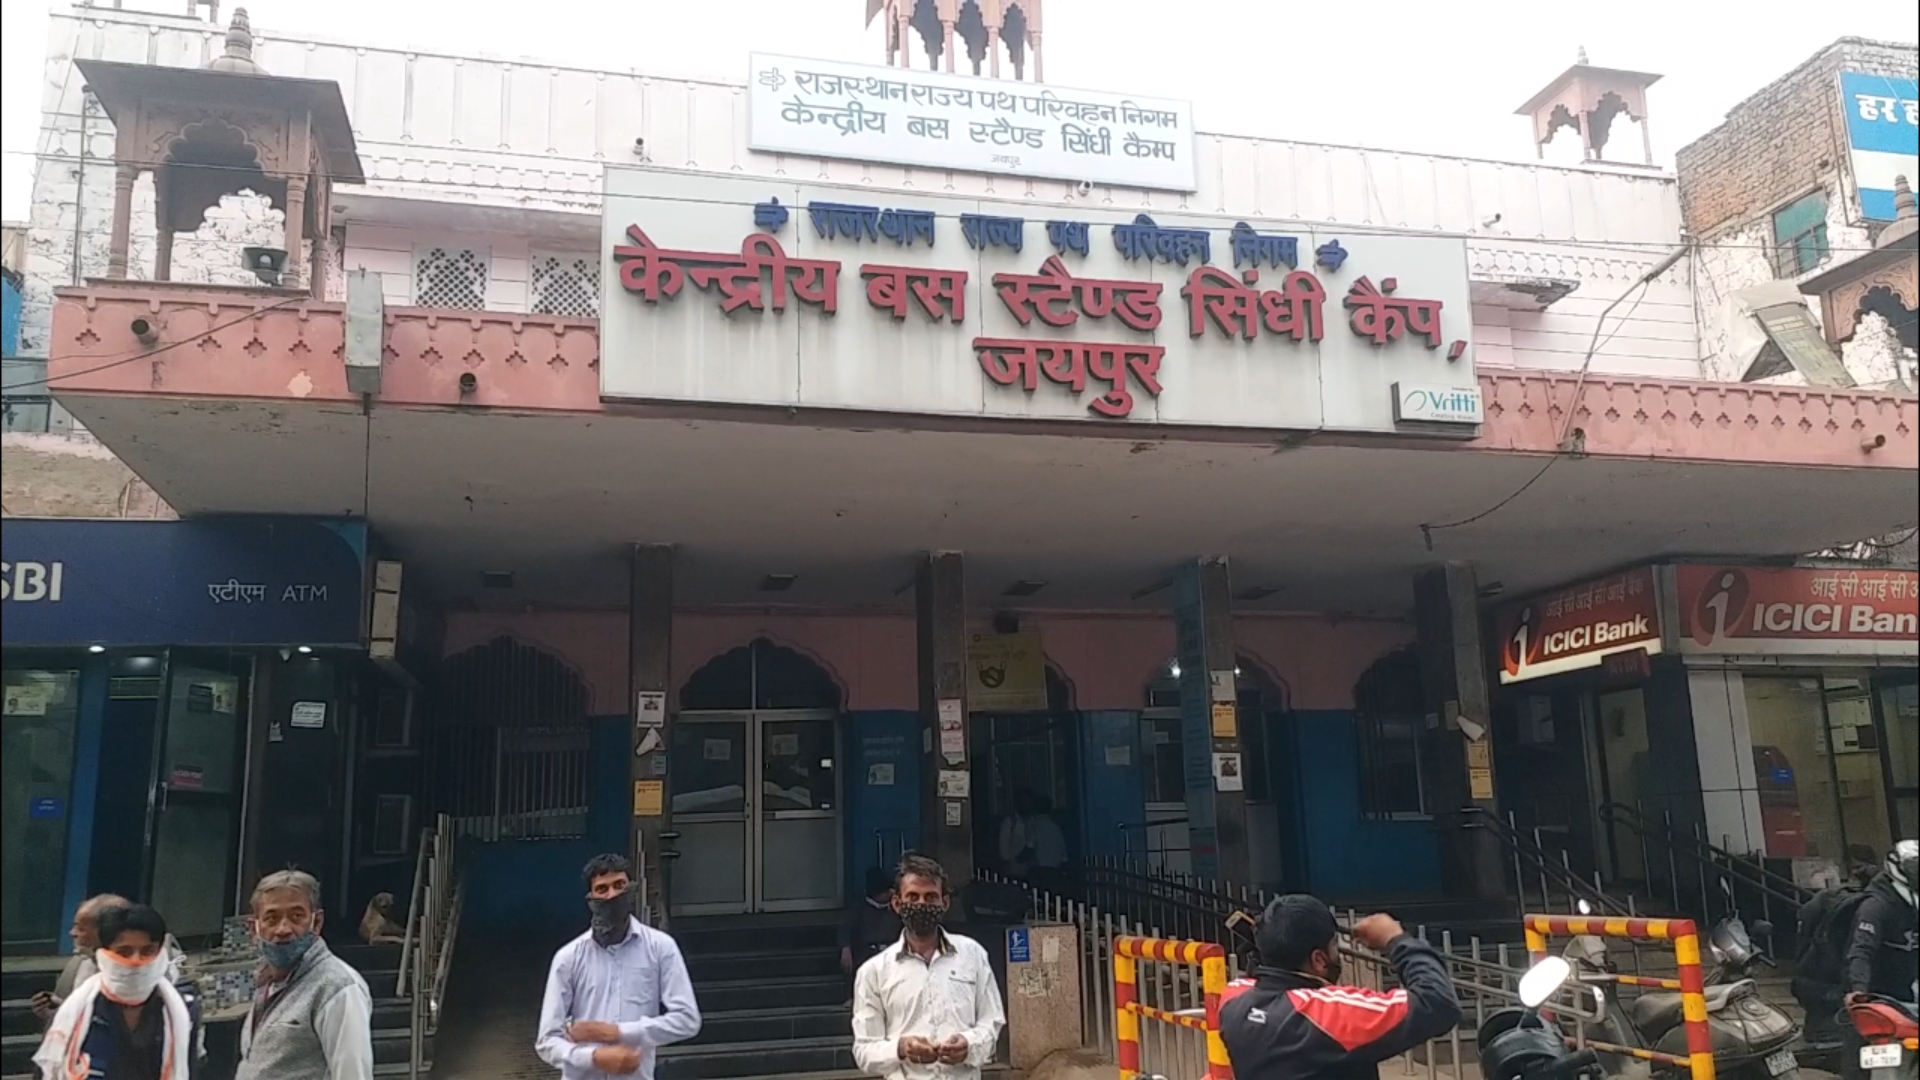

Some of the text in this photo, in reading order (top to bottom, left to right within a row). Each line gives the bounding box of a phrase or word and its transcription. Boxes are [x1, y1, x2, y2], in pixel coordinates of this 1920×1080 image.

[794, 70, 1178, 129] राजस्थान राज्य पथ परिवहन निगम
[1855, 93, 1899, 124] हर
[781, 94, 1177, 161] केन्द्रीय बस स्टैण्ड सिंधी कैम्प
[990, 153, 1022, 168] जयपुर
[959, 212, 1025, 254] राज्य
[1046, 218, 1090, 257] पथ
[1112, 213, 1211, 266] परिवहन
[1229, 221, 1298, 270] निगम
[613, 223, 842, 315] केन्द्रीय
[859, 262, 969, 323] बस
[992, 253, 1165, 333] स्टैण्ड
[1180, 265, 1327, 342] सिंधी
[972, 336, 1166, 418] जयपुर
[1428, 390, 1476, 413] Vritti
[208, 578, 267, 604] एटीएम
[281, 584, 328, 602] ATM
[1810, 573, 1837, 601] आई
[1841, 571, 1859, 597] सी
[1860, 573, 1888, 602] आई
[1890, 573, 1909, 599] सी
[1752, 602, 1843, 633] ICICI
[1543, 613, 1650, 656] ICICI Bank
